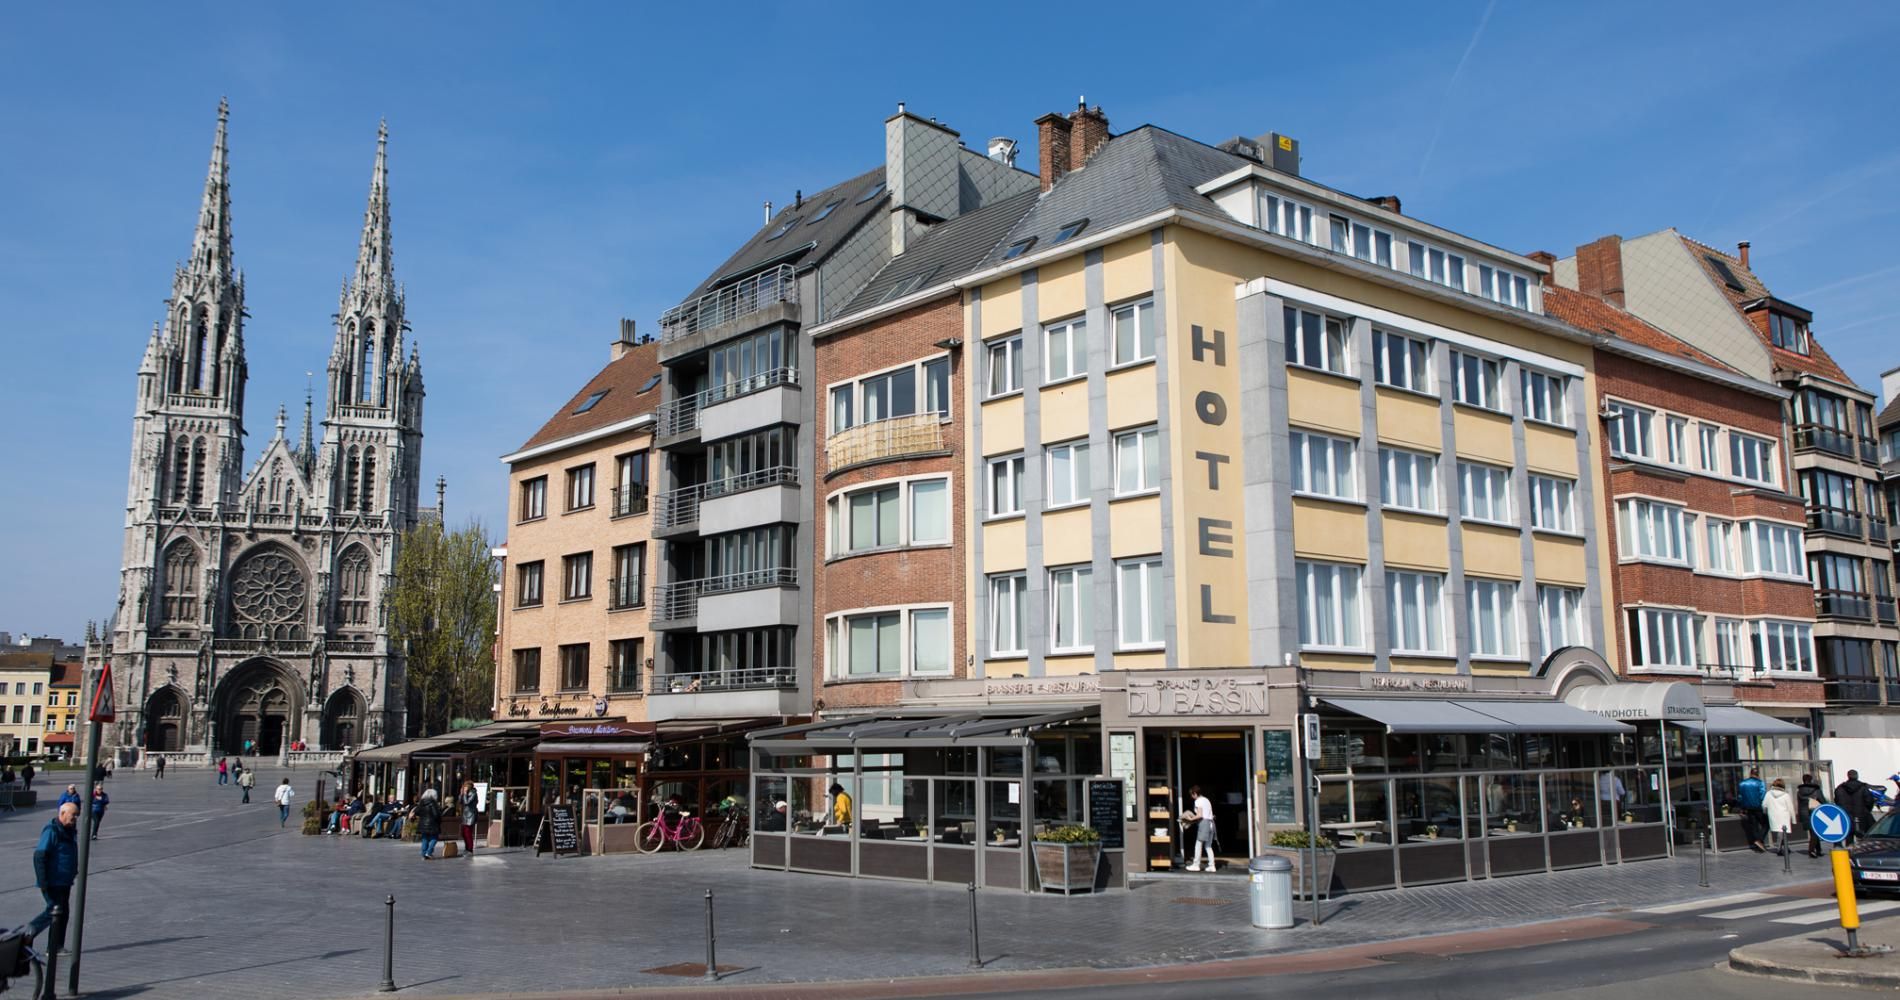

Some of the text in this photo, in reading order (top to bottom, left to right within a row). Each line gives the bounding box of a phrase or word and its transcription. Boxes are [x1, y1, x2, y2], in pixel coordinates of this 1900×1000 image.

[1191, 324, 1236, 624] HOTEL
[1048, 681, 1100, 694] RESTAURAN
[539, 702, 578, 719] Beethoven
[1129, 691, 1265, 714] DU BASSIN
[1667, 706, 1701, 715] STRANDHOTEL
